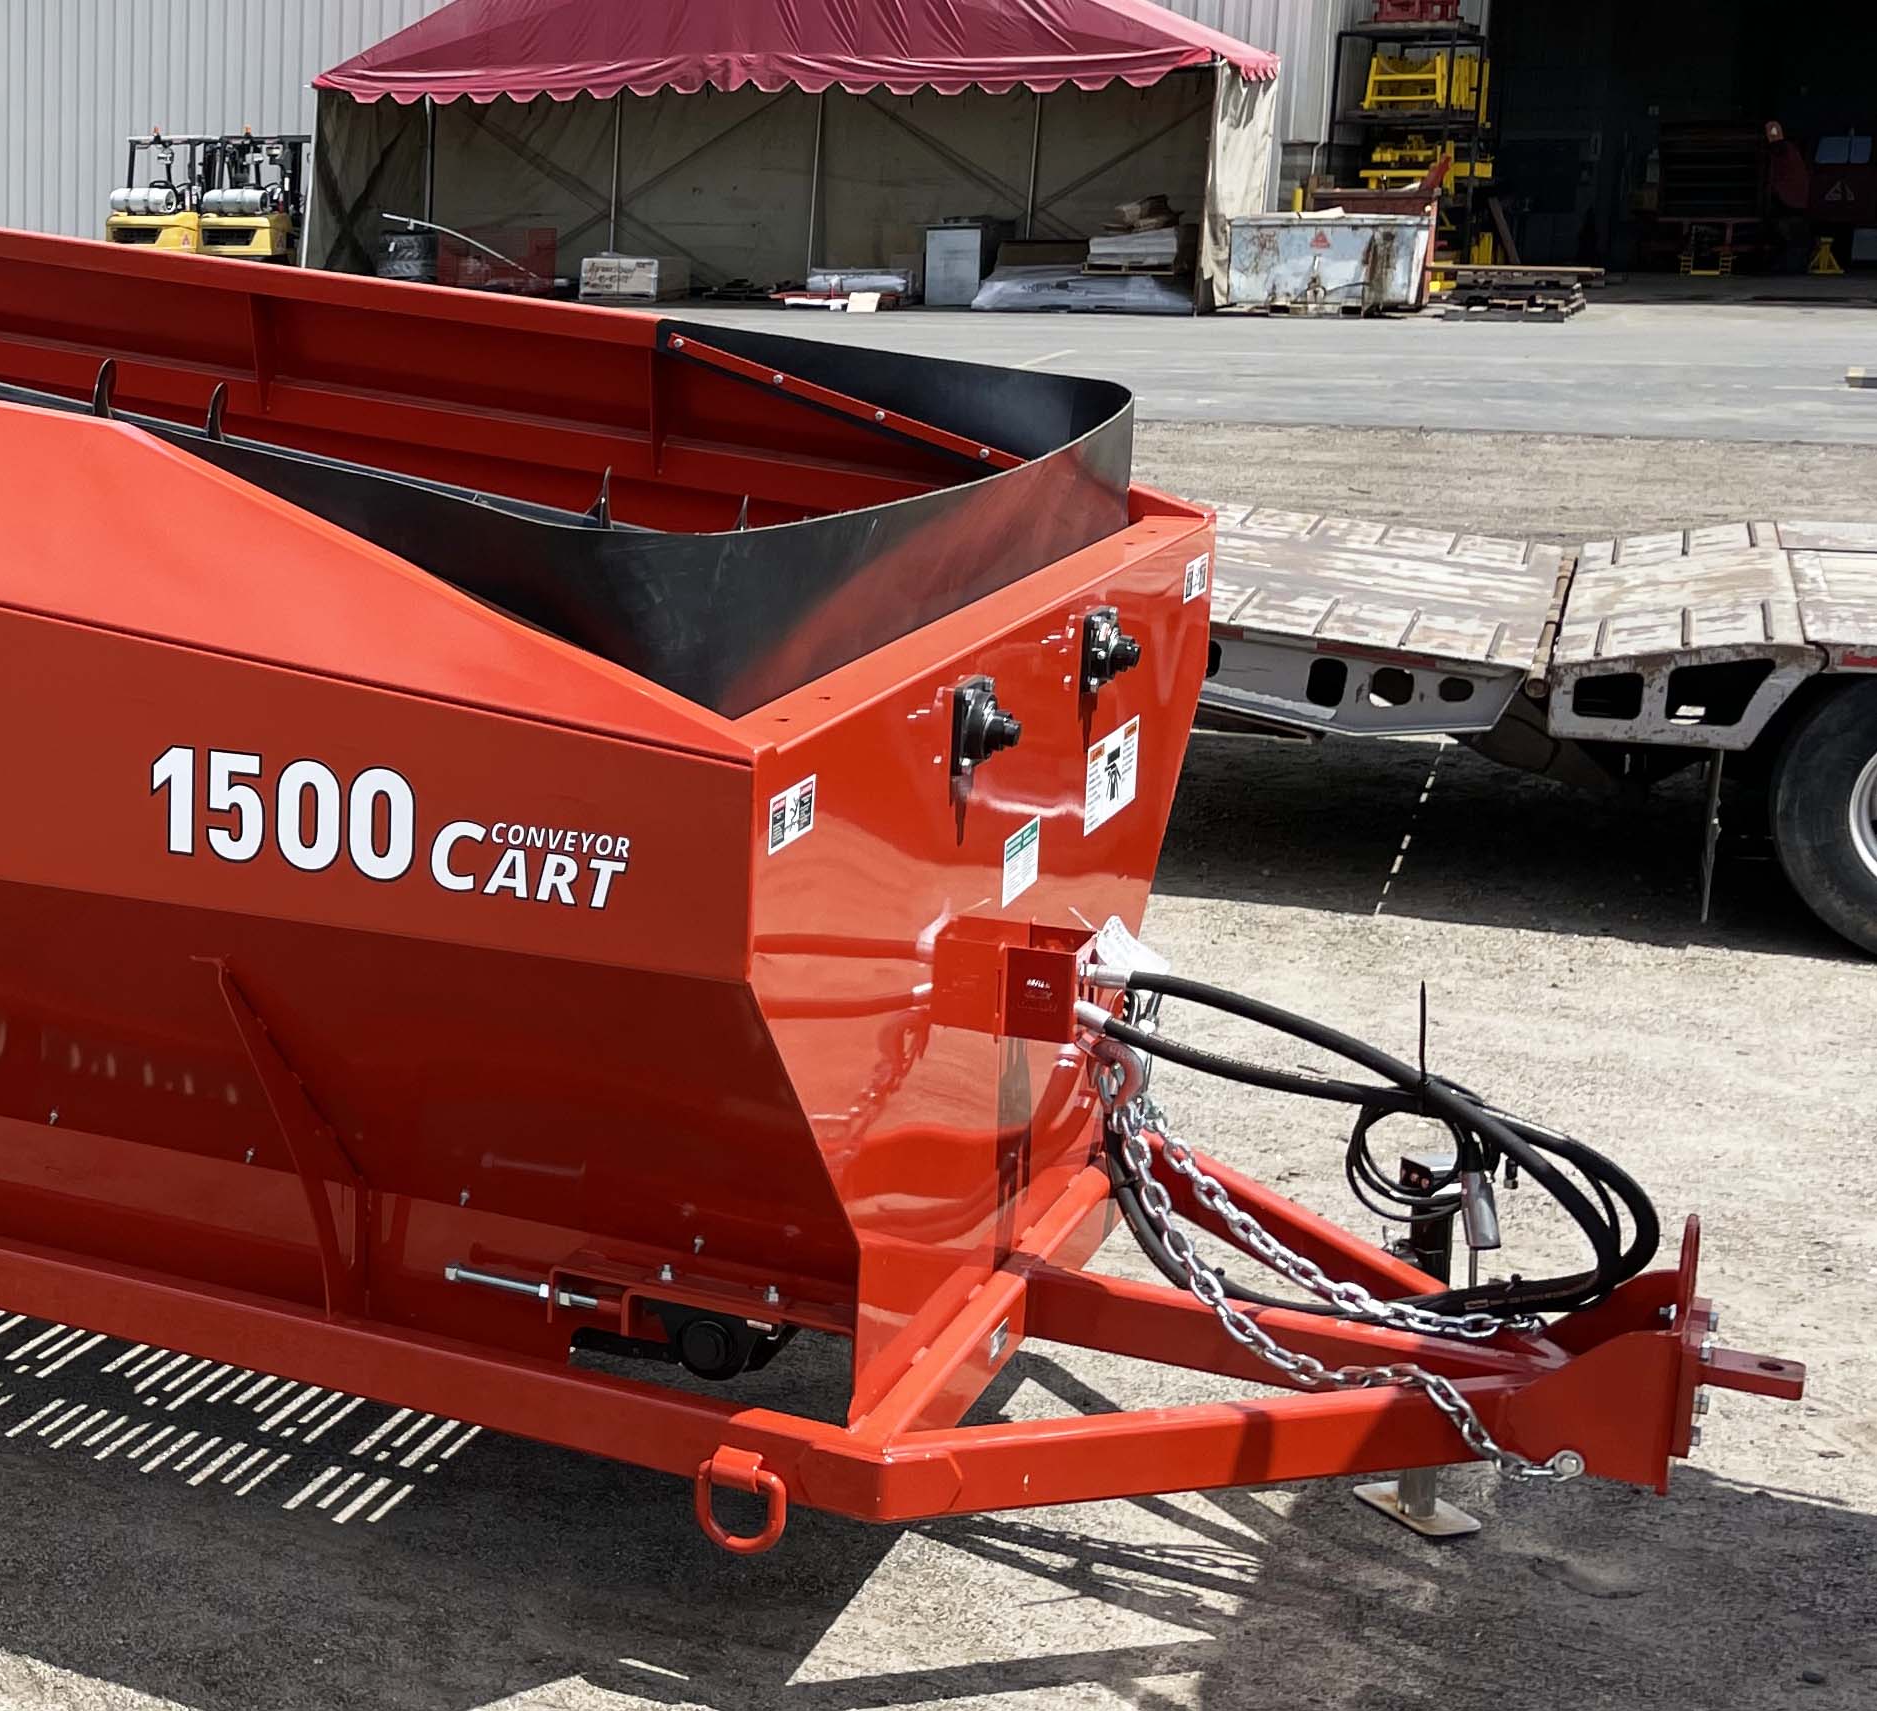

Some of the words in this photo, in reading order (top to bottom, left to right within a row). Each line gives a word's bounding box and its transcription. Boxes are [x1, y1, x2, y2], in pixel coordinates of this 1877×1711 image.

[150, 744, 416, 883] 1500
[429, 819, 628, 910] CART
[490, 821, 631, 859] CONVEYOR
